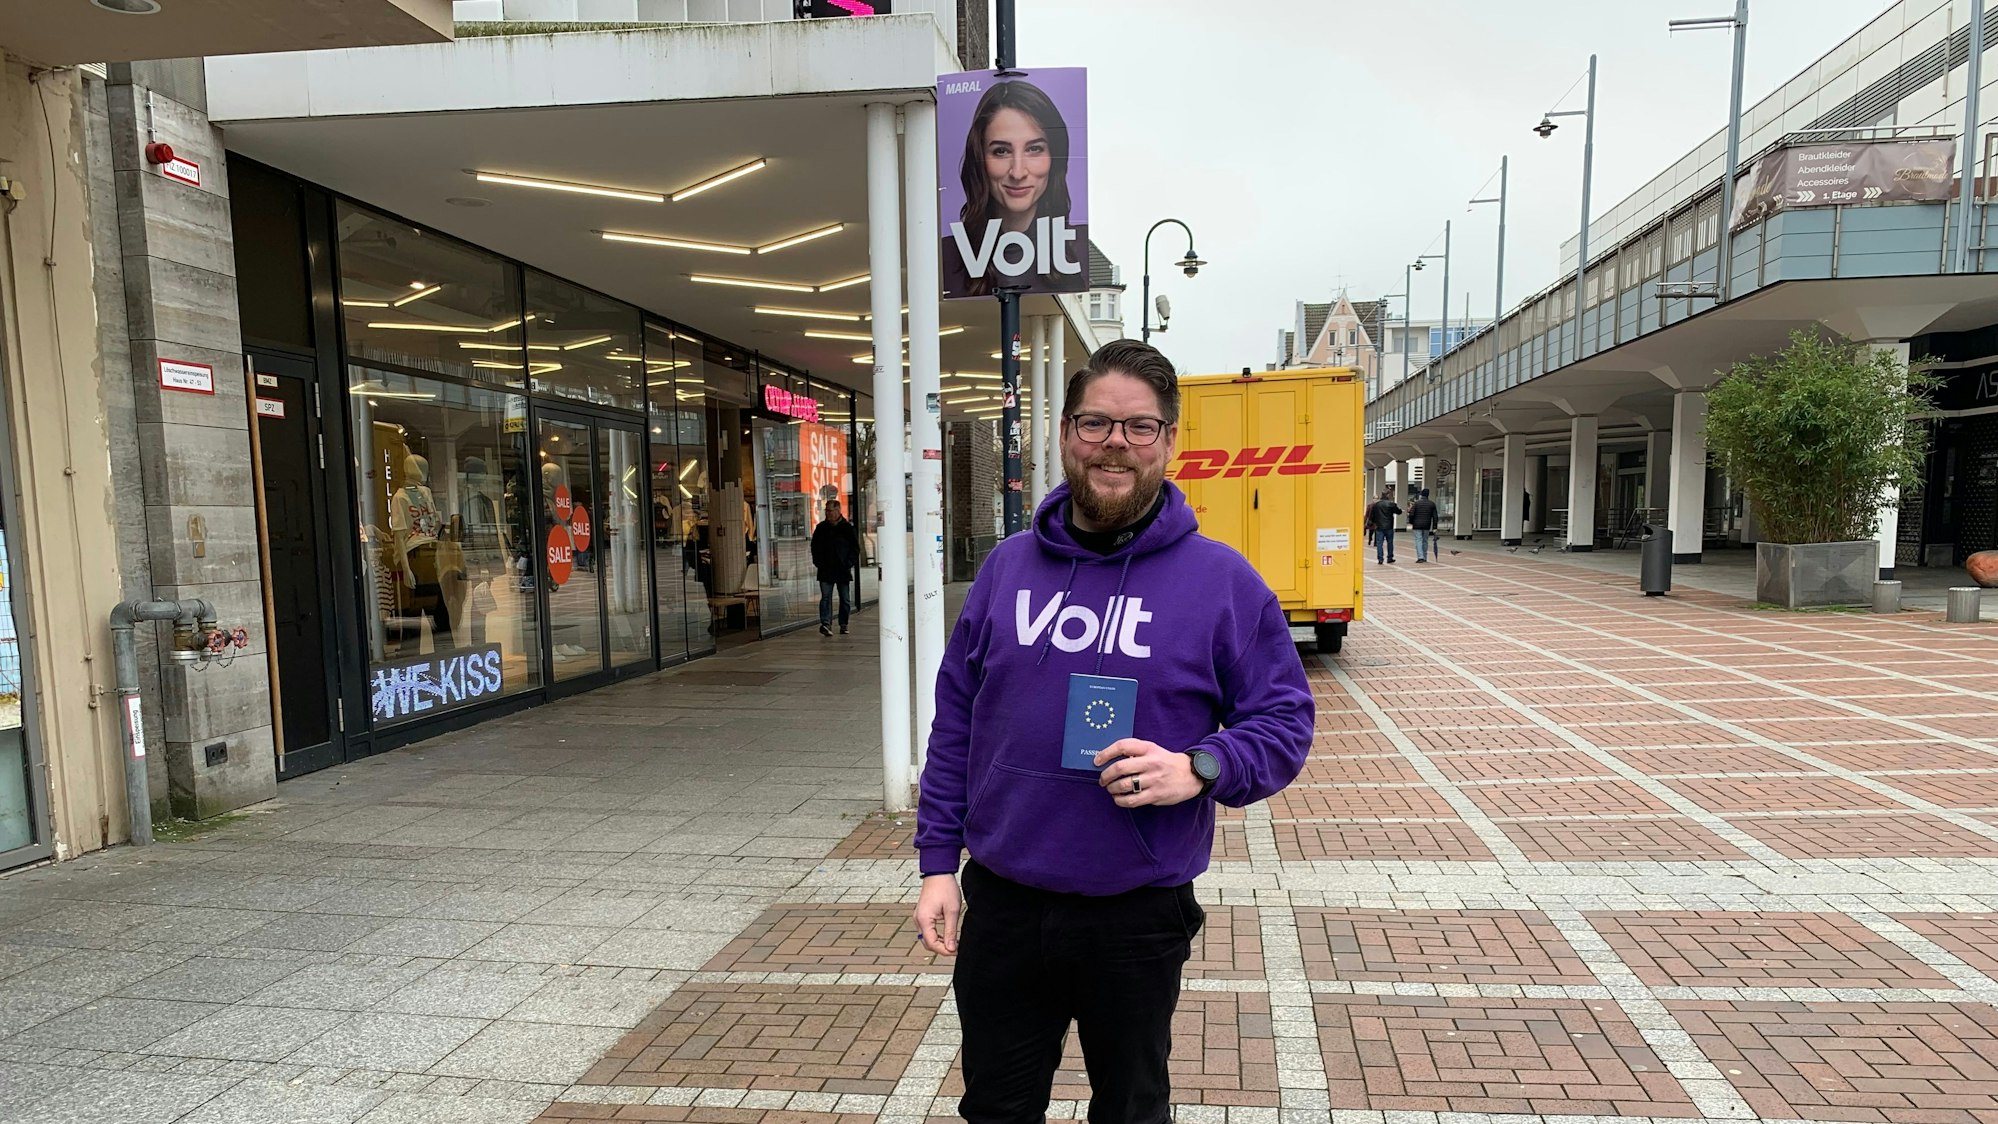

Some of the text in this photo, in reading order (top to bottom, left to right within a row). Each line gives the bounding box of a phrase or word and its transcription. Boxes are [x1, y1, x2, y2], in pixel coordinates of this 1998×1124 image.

[945, 80, 982, 96] MARAL
[1798, 150, 1852, 161] Brautkleider
[1797, 163, 1856, 174] Abendkleider
[1797, 176, 1849, 187] Accessoires
[1832, 190, 1858, 201] Etage
[950, 215, 1082, 279] Volt
[264, 403, 275, 412] SPZ
[810, 431, 838, 469] SALE
[1174, 444, 1323, 480] DHL
[556, 499, 570, 509] SALE
[572, 522, 590, 536] SALE
[548, 547, 571, 564] SALE
[1015, 588, 1153, 659] Volt
[439, 649, 501, 705] KISS
[132, 709, 142, 745] Einspeisung
